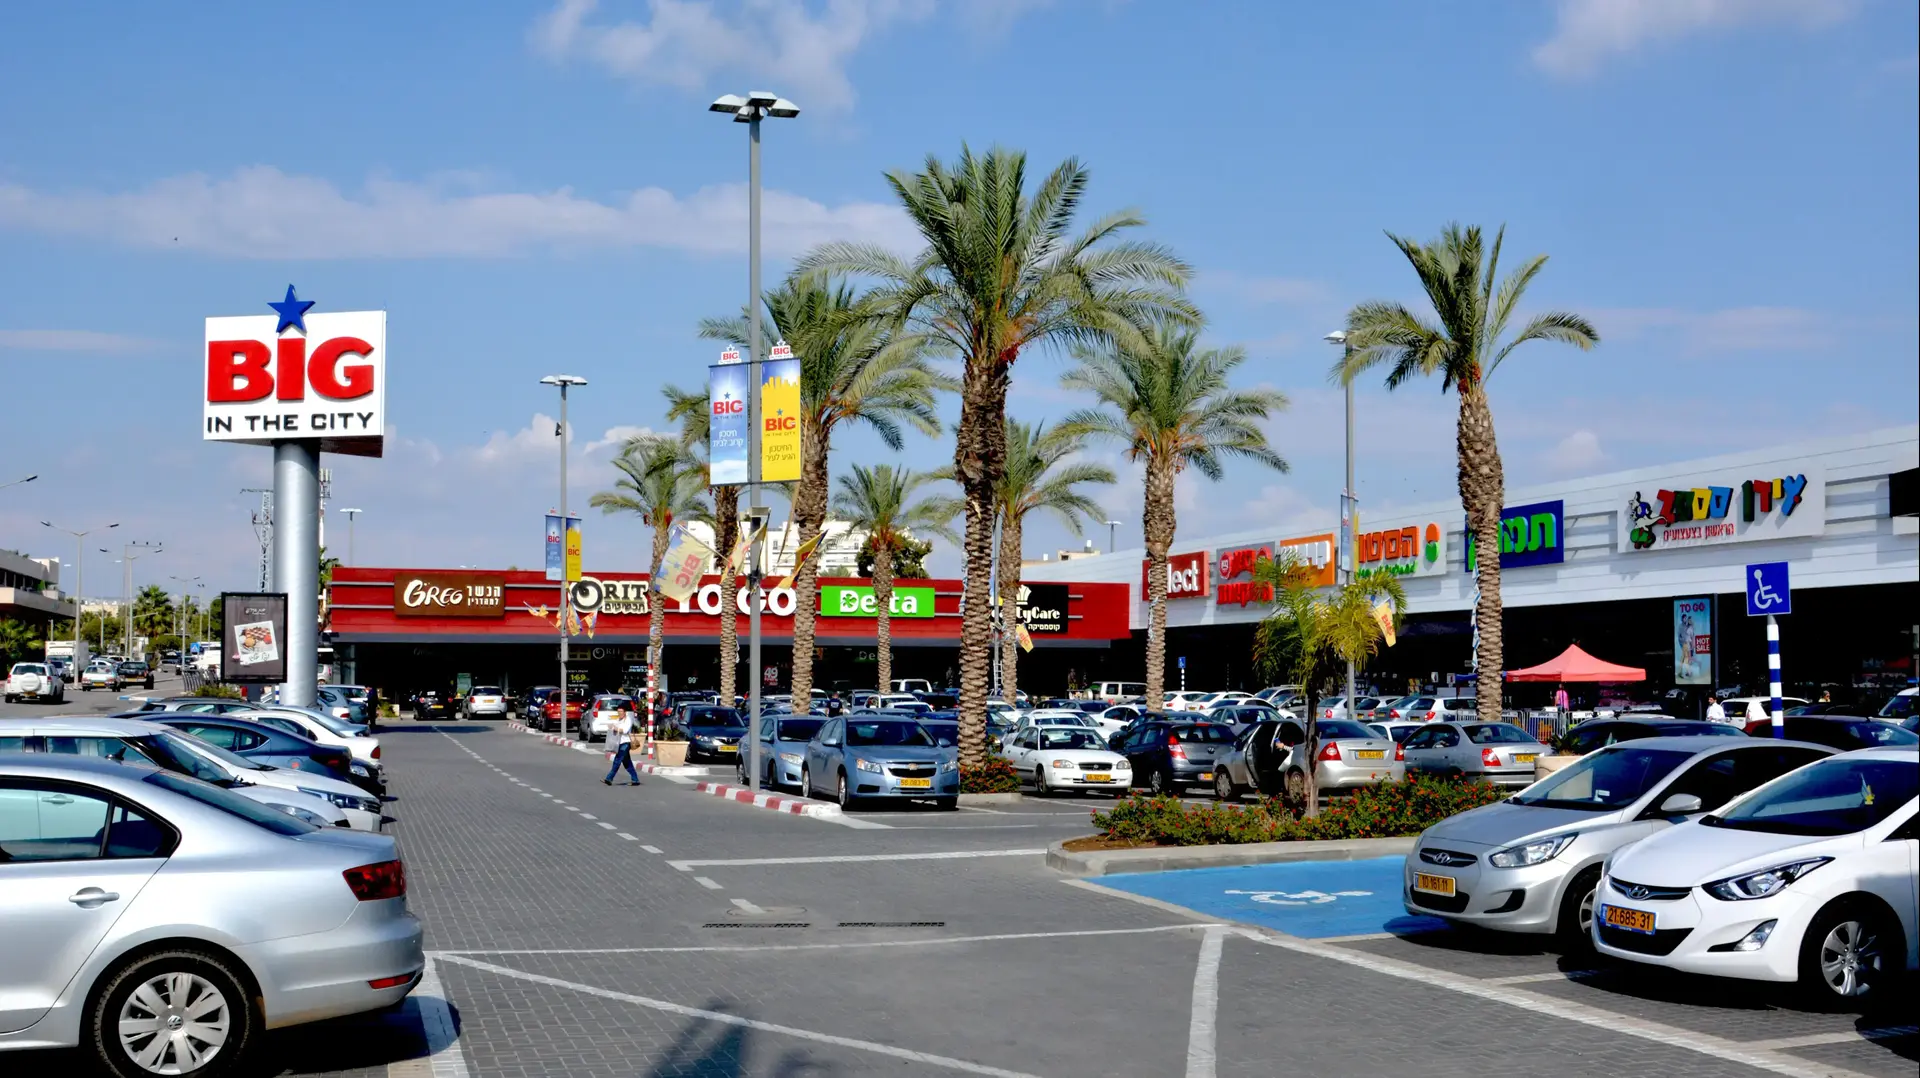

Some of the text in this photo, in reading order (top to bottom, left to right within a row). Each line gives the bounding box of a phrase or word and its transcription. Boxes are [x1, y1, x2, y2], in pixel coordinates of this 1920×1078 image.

[723, 352, 738, 360] BIG
[773, 347, 790, 355] BIG
[207, 336, 375, 402] BIG
[713, 400, 743, 414] BIG
[207, 412, 374, 433] IN THE CITY
[765, 417, 796, 431] BIG
[1741, 474, 1807, 522] עידן
[1148, 560, 1199, 593] lect
[571, 579, 647, 611] ORIT
[840, 589, 917, 614] Deta
[604, 602, 645, 612] תכשיטים
[1680, 603, 1705, 613] TO GO
[764, 667, 778, 679] 49
